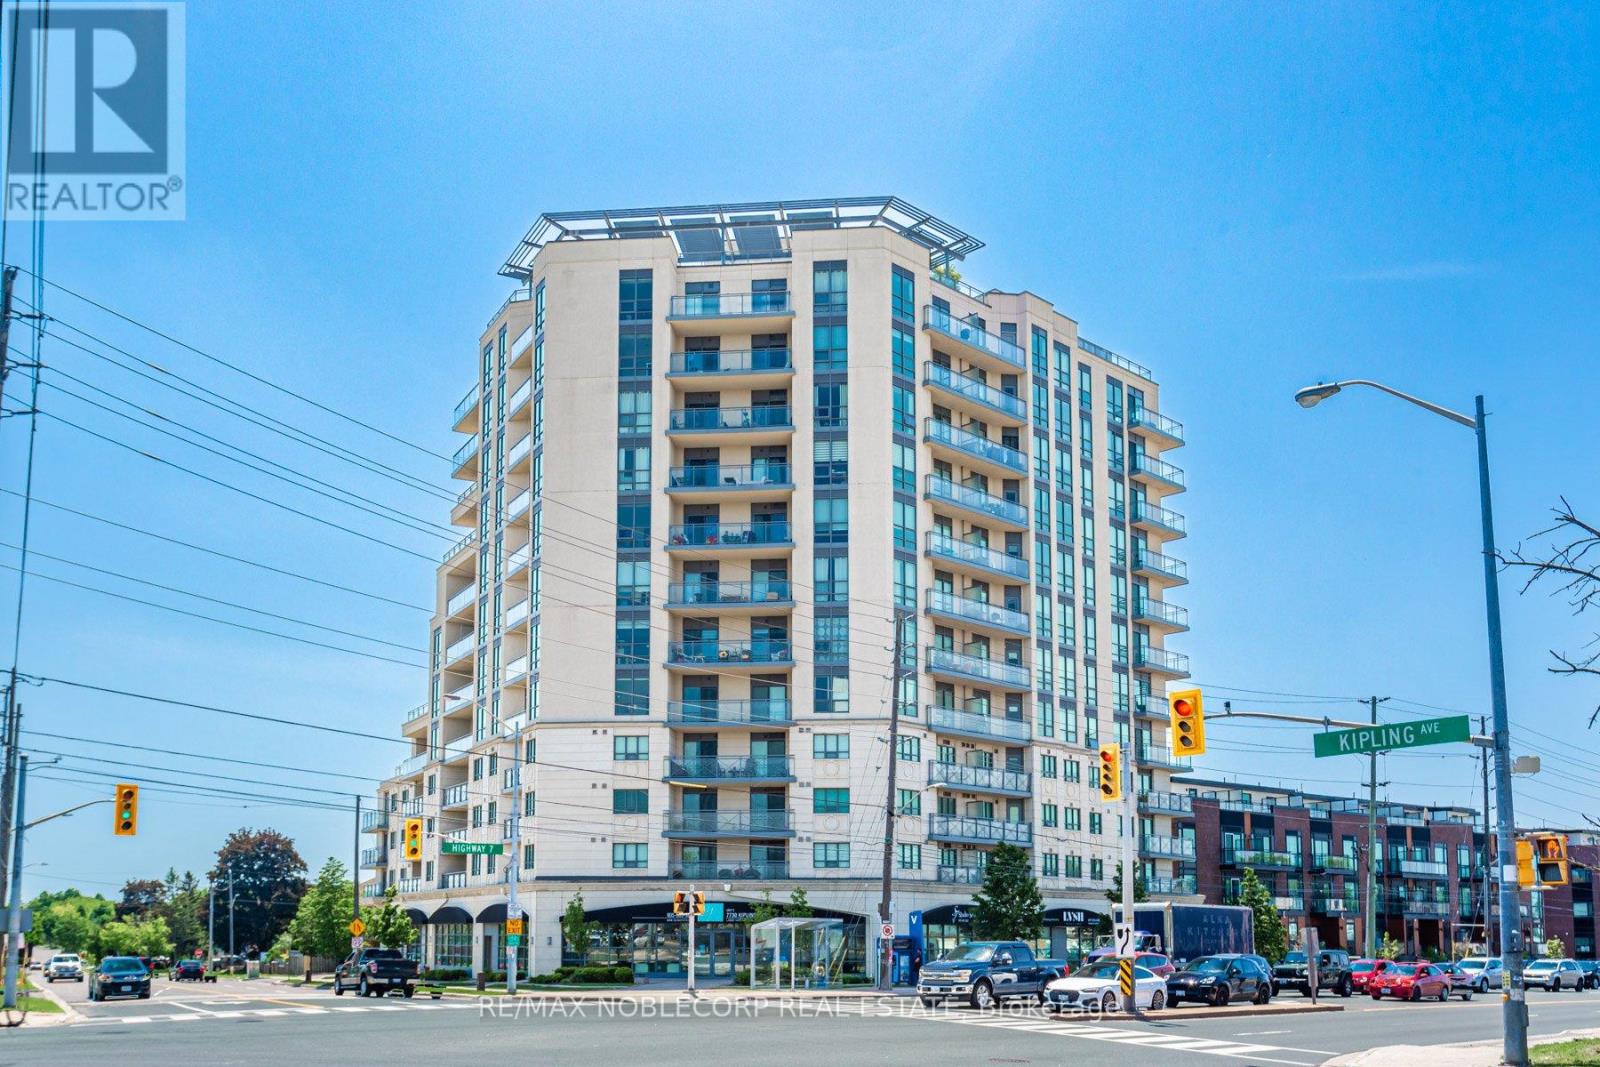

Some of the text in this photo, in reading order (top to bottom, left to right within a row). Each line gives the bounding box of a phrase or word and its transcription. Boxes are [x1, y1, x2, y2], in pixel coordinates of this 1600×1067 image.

[1339, 721, 1441, 752] KIPLING AVE
[452, 843, 494, 853] HIGHWAY 7
